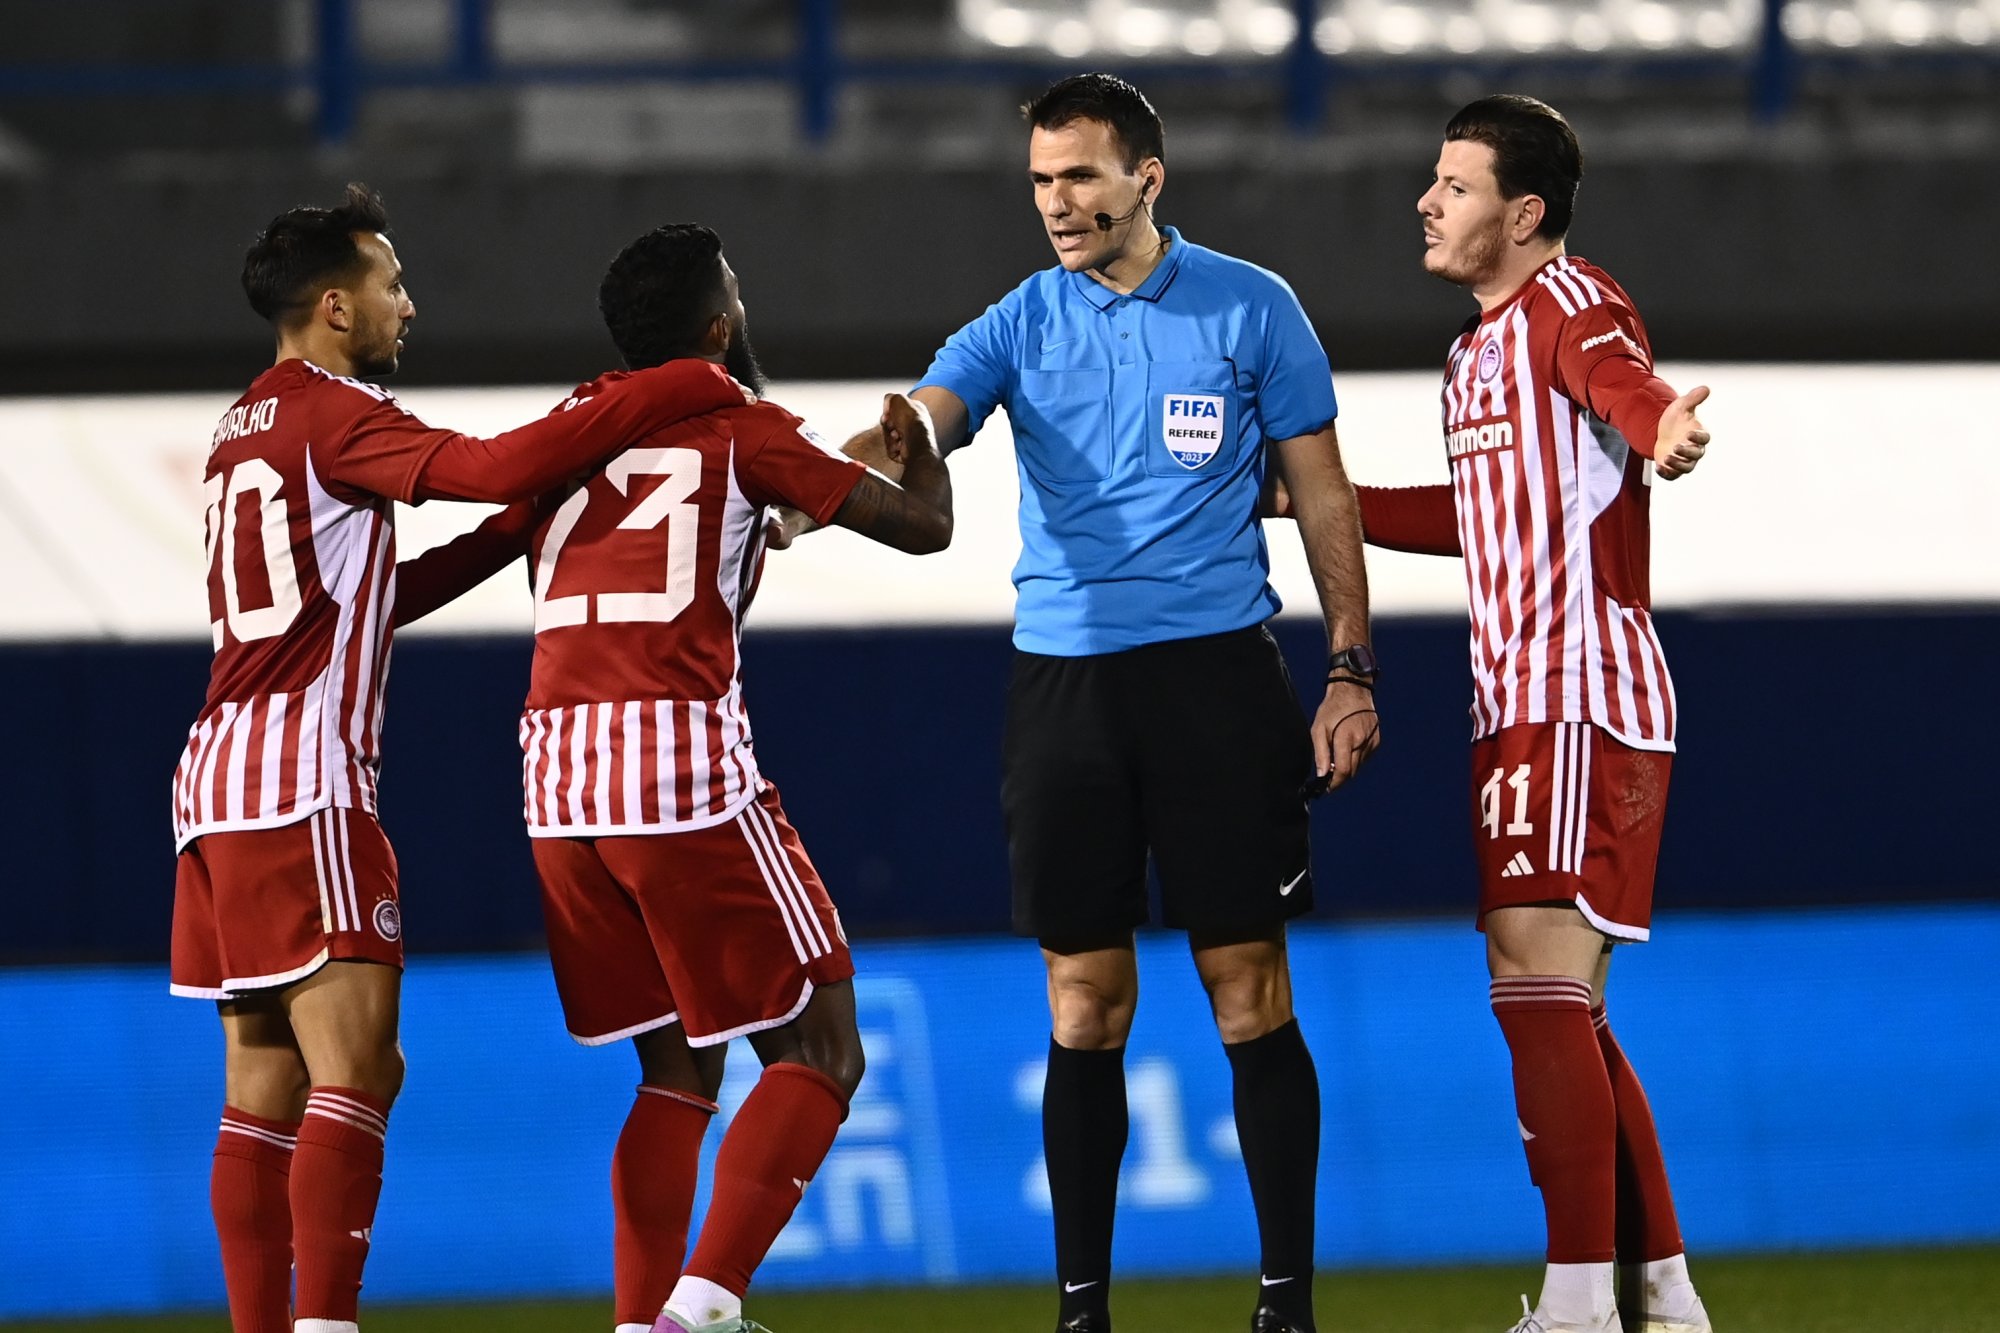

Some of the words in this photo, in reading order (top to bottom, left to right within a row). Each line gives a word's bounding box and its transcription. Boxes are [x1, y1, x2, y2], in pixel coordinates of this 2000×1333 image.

[1169, 399, 1218, 418] FIFA
[1168, 428, 1218, 440] REFEREE
[1180, 452, 1203, 463] 2023
[534, 447, 702, 634] 23
[1481, 764, 1533, 839] 41
